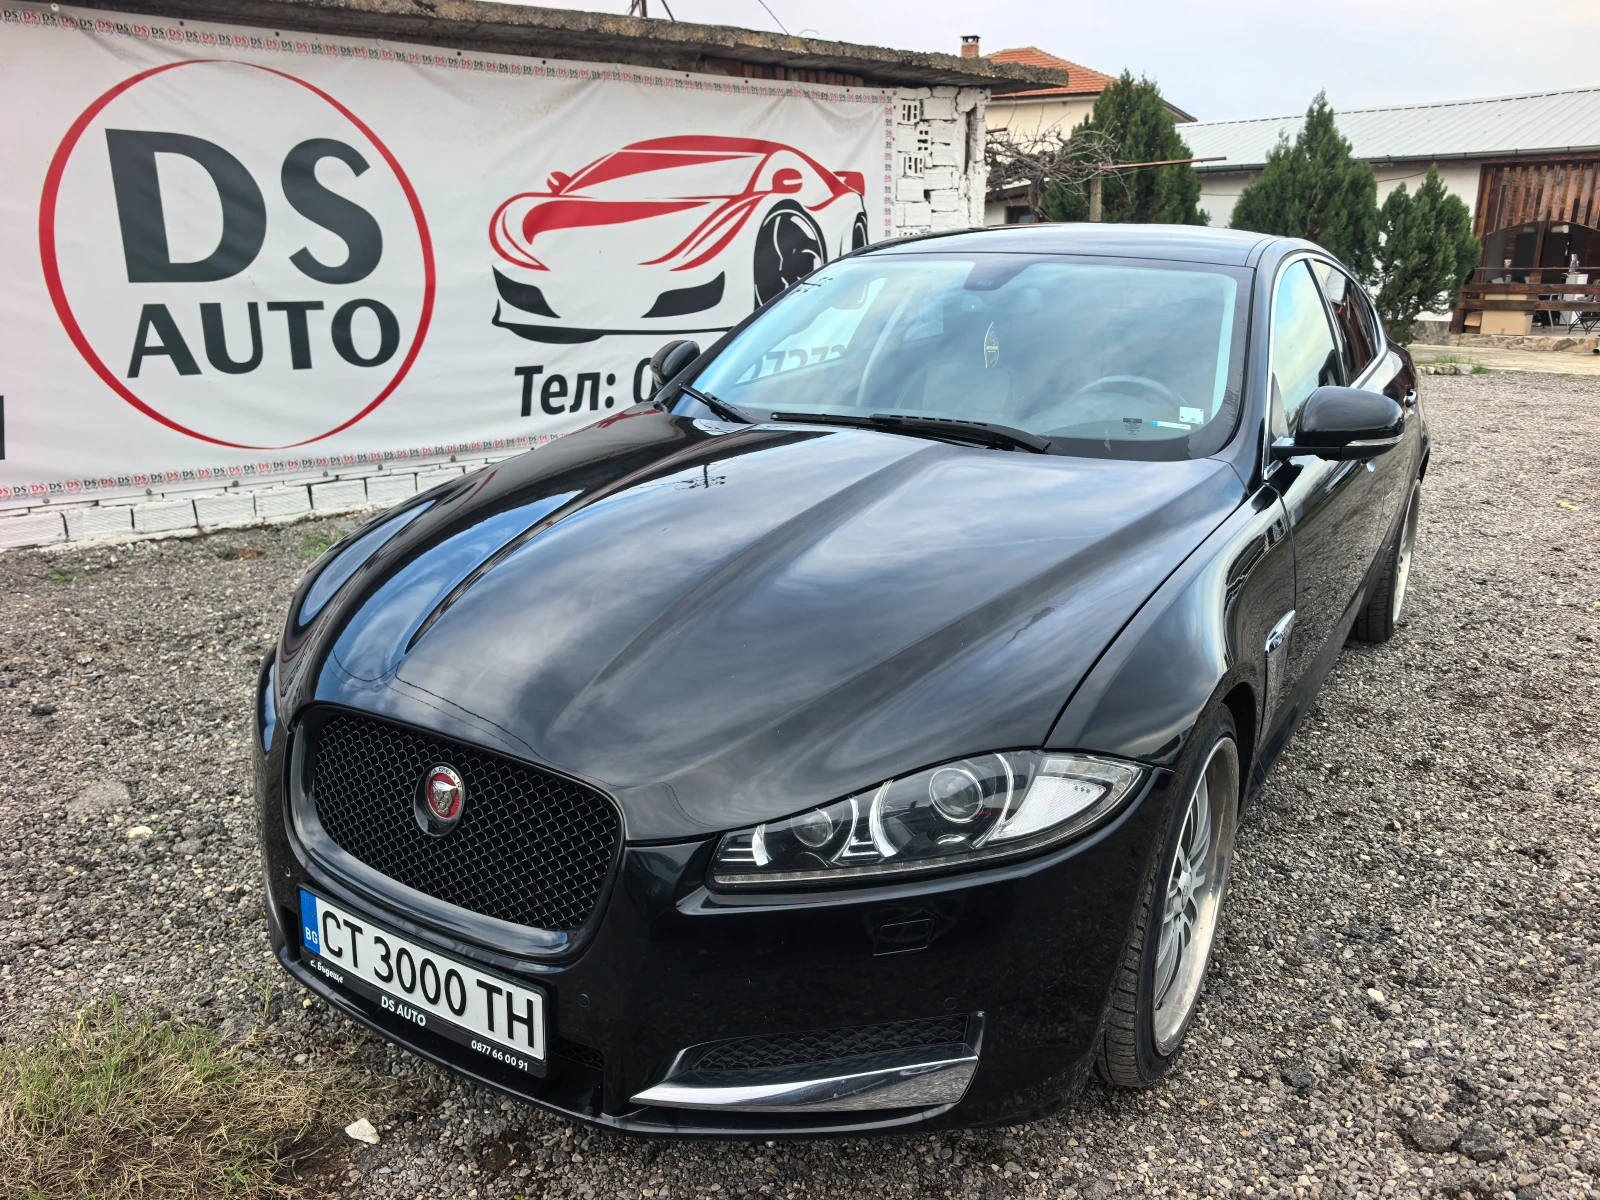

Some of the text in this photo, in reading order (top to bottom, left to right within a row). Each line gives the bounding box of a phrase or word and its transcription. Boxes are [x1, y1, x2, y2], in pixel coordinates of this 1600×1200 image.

[3, 10, 17, 18] DS
[23, 11, 37, 20] DS
[42, 13, 56, 22] DS
[60, 15, 75, 25] DS
[79, 18, 93, 27] DS
[98, 20, 112, 29] DS
[115, 22, 129, 32] DS
[133, 25, 146, 34] DS
[151, 27, 164, 35] DS
[168, 29, 181, 37] DS
[185, 31, 198, 39] DS
[202, 33, 214, 41] DS
[234, 36, 246, 44] DS
[250, 37, 262, 45] DS
[266, 39, 277, 47] DS
[281, 41, 292, 49] DS
[296, 42, 307, 50] DS
[311, 44, 322, 52] DS
[105, 128, 383, 284] DS
[127, 298, 400, 378] AUTO
[514, 365, 616, 417] Тел:
[13, 486, 26, 494] DS
[31, 484, 46, 492] DS
[49, 482, 62, 490] DS
[66, 480, 79, 489] DS
[83, 479, 96, 487] DS
[101, 477, 113, 485] DS
[117, 475, 130, 484] DS
[134, 474, 146, 482] DS
[150, 472, 162, 480] DS
[166, 471, 178, 479] DS
[182, 469, 194, 477] DS
[198, 468, 209, 476] DS
[213, 466, 224, 474] DS
[228, 465, 239, 473] DS
[243, 464, 254, 472] DS
[258, 462, 269, 470] DS
[273, 460, 283, 468] DS
[287, 459, 298, 467] DS
[302, 458, 312, 466] DS
[316, 457, 326, 465] DS
[305, 926, 318, 944] BG
[322, 910, 535, 1049] CT 3000 TH
[381, 995, 426, 1027] DS AUTO
[471, 1040, 529, 1072] 0877 66 00 91
